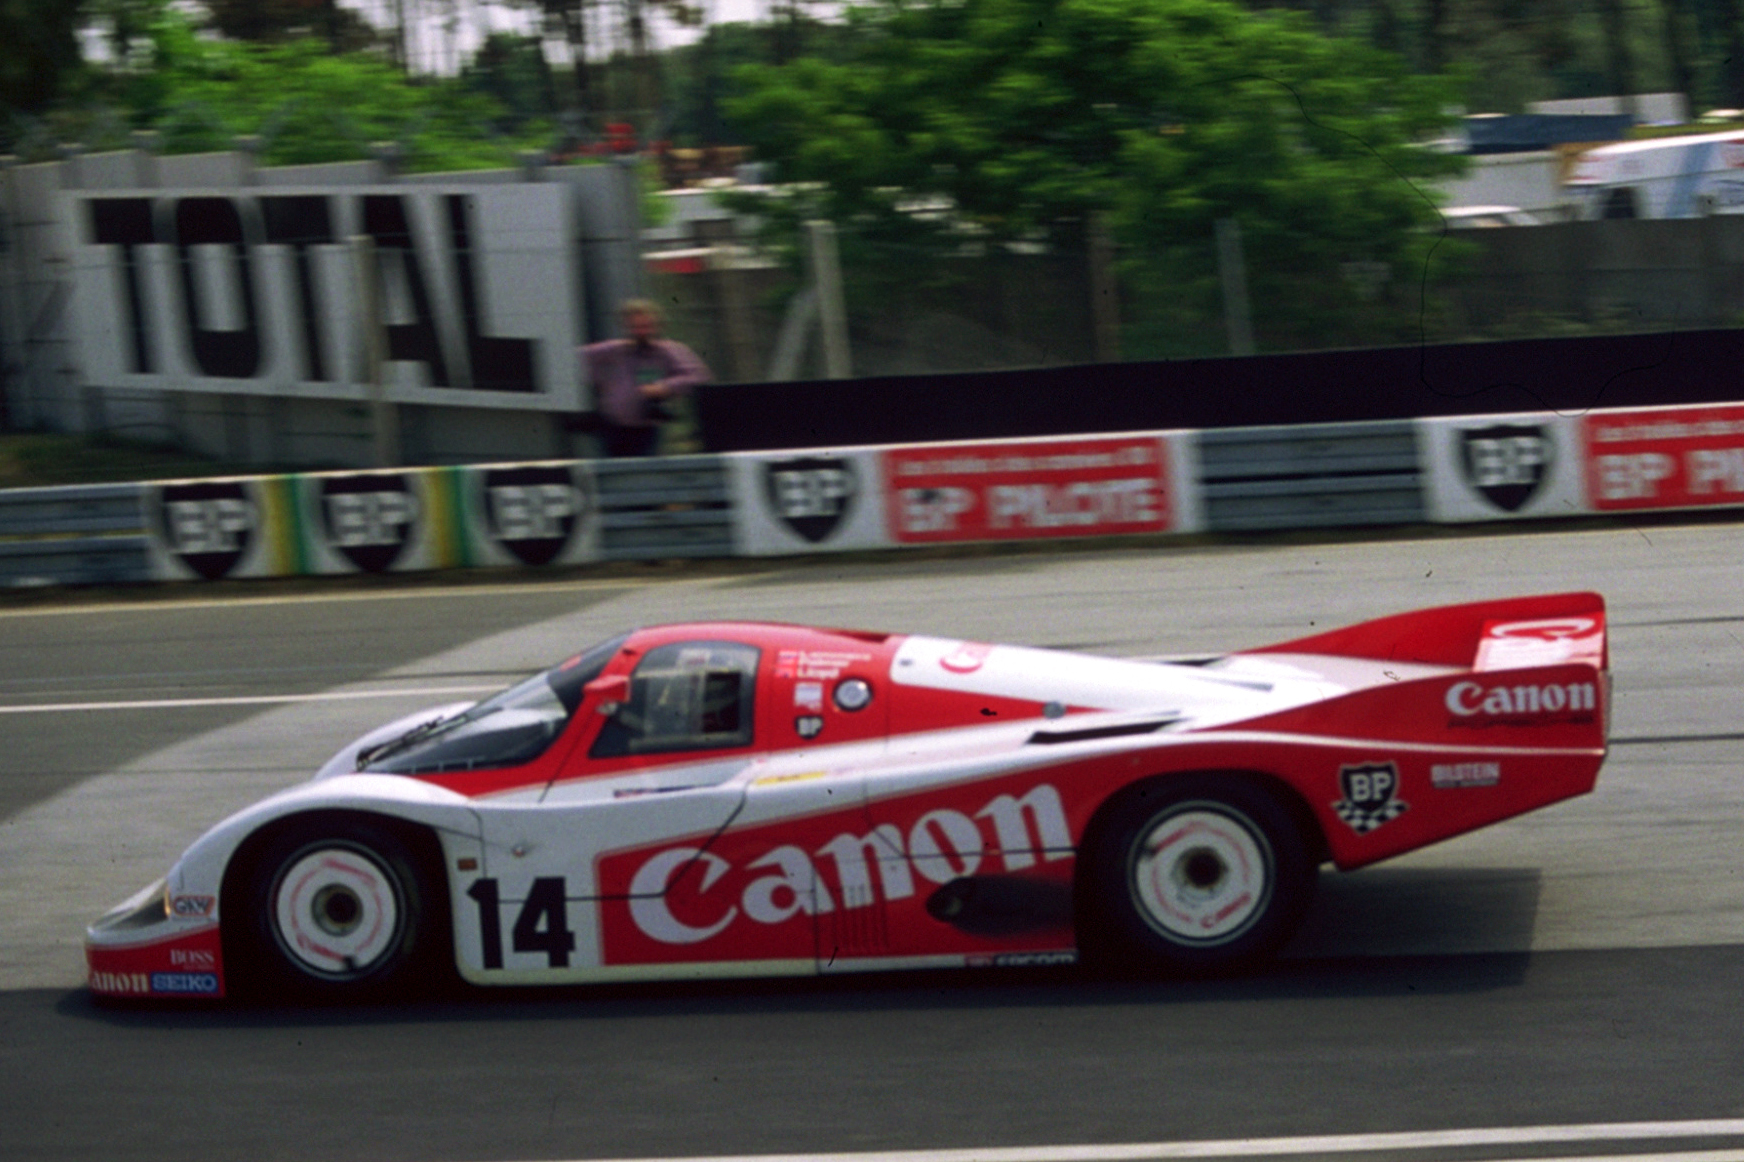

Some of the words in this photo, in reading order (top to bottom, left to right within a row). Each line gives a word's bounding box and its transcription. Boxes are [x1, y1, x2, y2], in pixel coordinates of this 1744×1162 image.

[88, 193, 545, 393] TOTAL
[1468, 437, 1547, 487] BP
[1597, 453, 1676, 498] BP
[1686, 446, 1744, 494] PI
[492, 484, 579, 540] BP
[773, 469, 852, 517] BP
[899, 487, 976, 532] BP
[988, 477, 1159, 529] PILOTE
[167, 499, 256, 555] BP
[331, 492, 415, 547] BP
[1444, 681, 1596, 716] Canon
[798, 716, 823, 737] BP
[1350, 771, 1392, 801] BP
[627, 782, 1074, 944] Canon
[467, 876, 576, 970] 14
[92, 971, 149, 993] anon
[152, 972, 218, 991] SEIKO
